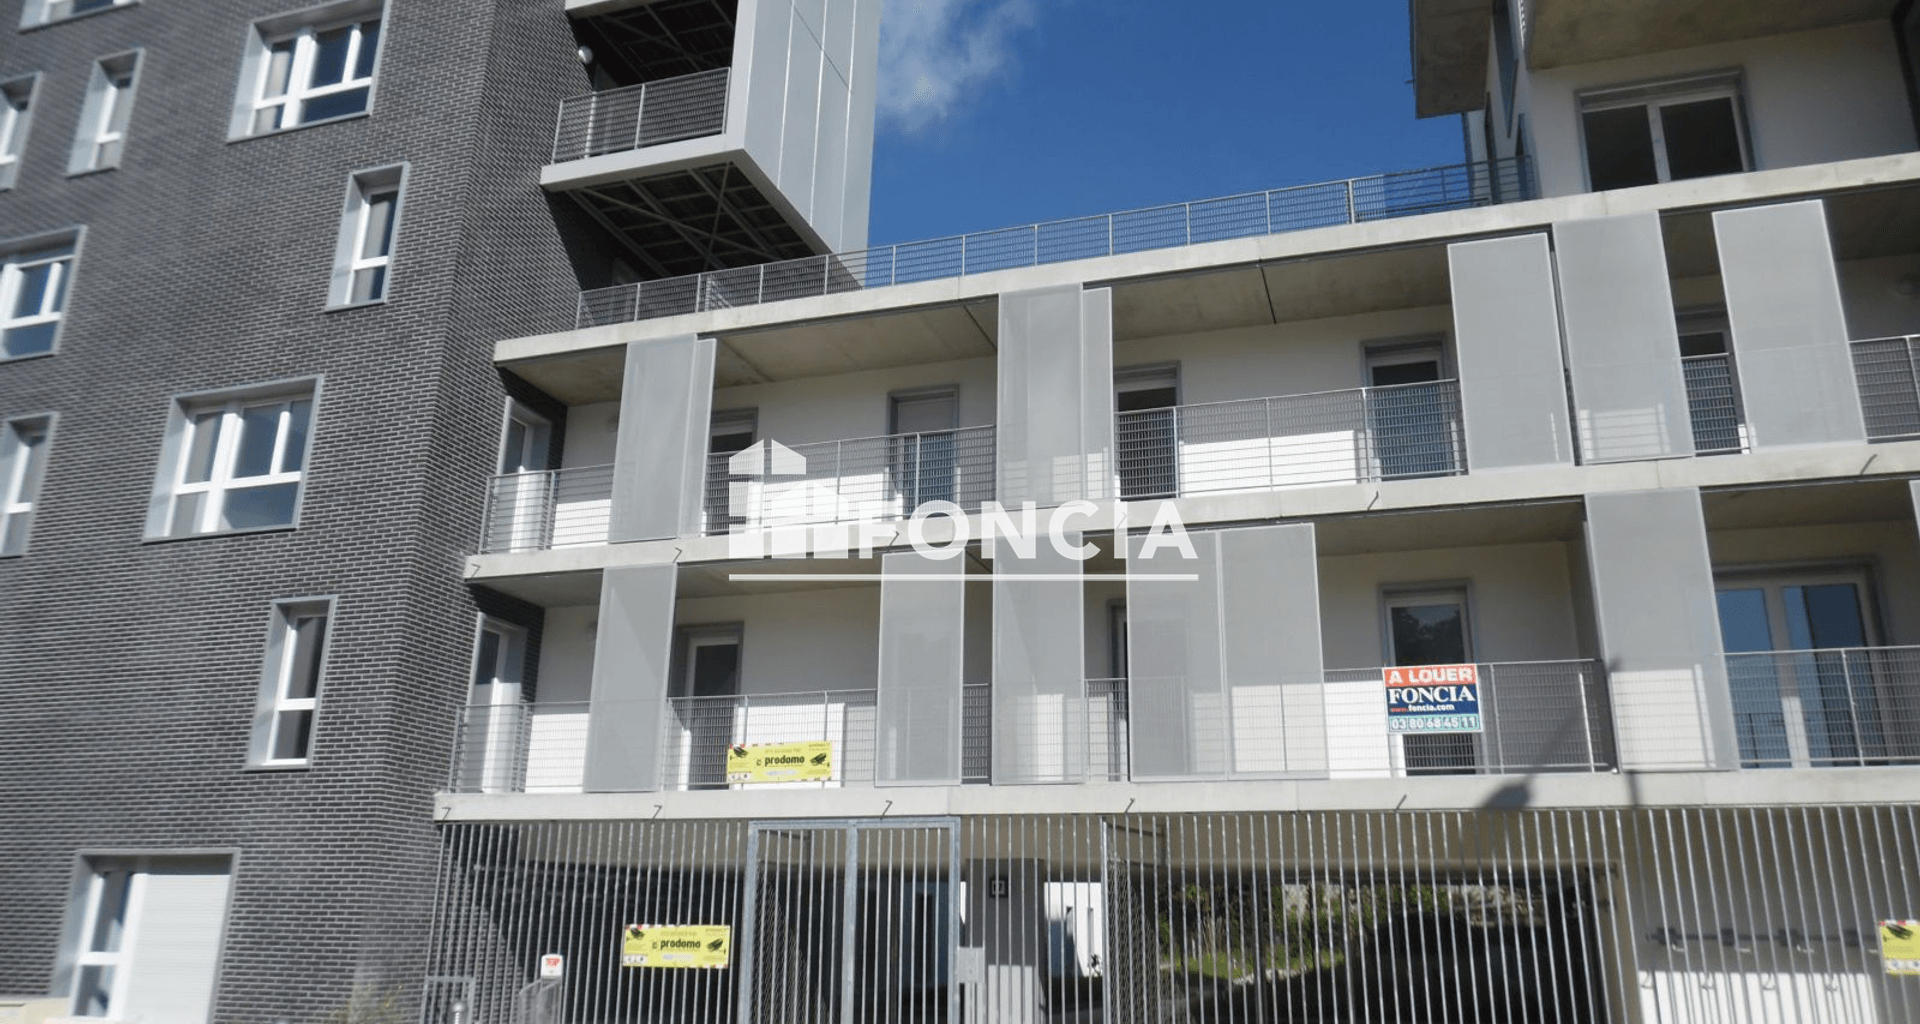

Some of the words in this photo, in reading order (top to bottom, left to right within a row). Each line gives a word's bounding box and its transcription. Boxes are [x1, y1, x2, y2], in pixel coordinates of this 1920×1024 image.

[1389, 670, 1404, 684] A
[1408, 667, 1473, 684] LOUER
[1389, 686, 1475, 704] FONCIA
[1391, 717, 1407, 730] 03
[764, 754, 805, 767] prodomo
[660, 939, 701, 951] prodomo
